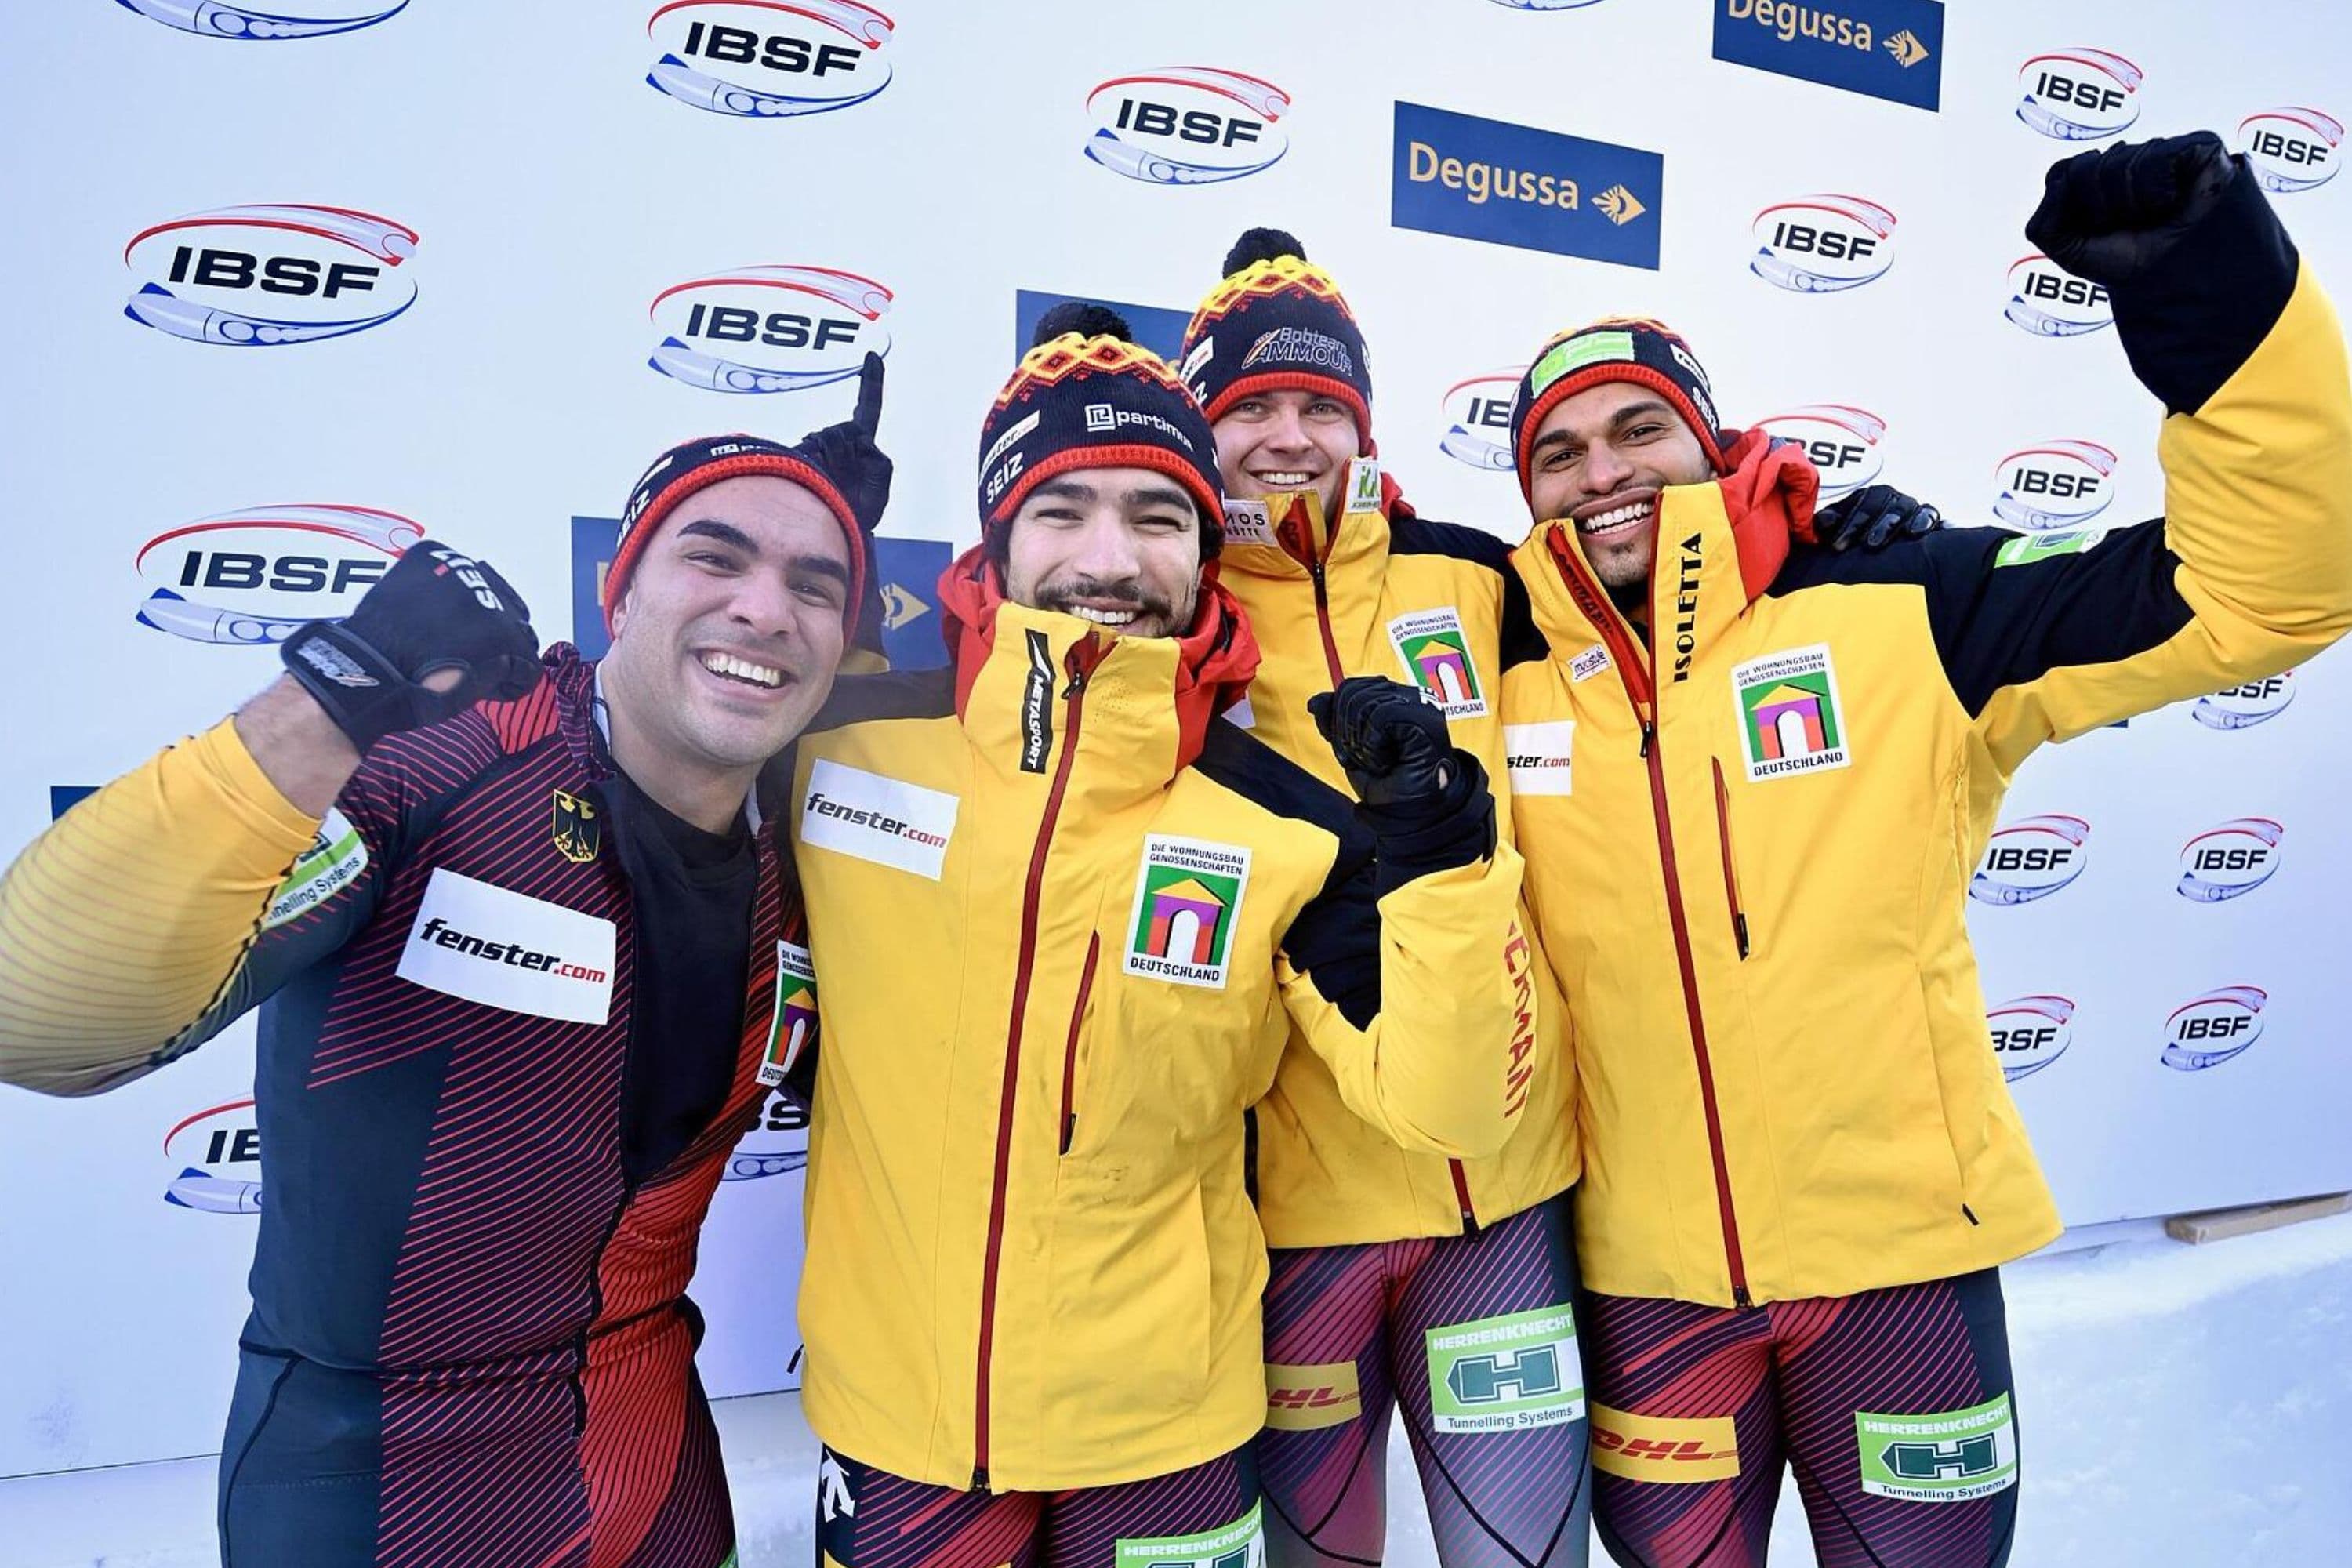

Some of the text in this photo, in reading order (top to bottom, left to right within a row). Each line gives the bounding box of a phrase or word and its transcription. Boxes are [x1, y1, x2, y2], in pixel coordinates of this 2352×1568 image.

[1729, 0, 1872, 52] Degussa
[684, 21, 861, 77] IBSF
[2036, 72, 2125, 114] IBSF
[1116, 99, 1262, 148] IBSF
[2252, 130, 2328, 166] IBSF
[1409, 141, 1578, 210] Degussa
[1773, 222, 1876, 263] IBSF
[169, 246, 380, 299] IBSF
[2024, 272, 2108, 307] IBSF
[685, 303, 860, 351] IBSF
[1279, 327, 1350, 352] Bobteam
[1255, 340, 1352, 376] AMMOUR
[1467, 397, 1511, 428] IB
[2013, 468, 2100, 499] IBSF
[180, 551, 387, 593] IBSF
[1674, 532, 1702, 683] ISOLETTA
[1753, 653, 1823, 673] WOHNUNGSBAU
[1026, 674, 1044, 769] METASPORT
[1507, 755, 1570, 769] ster.com
[1754, 751, 1844, 777] DEUTSCHLAND
[807, 792, 947, 848] fenster.com
[1149, 853, 1243, 876] GENOSSENSCHAFTEN
[1152, 844, 1166, 853] DIE
[1170, 846, 1244, 866] WOHNUNGSBAU
[1986, 848, 2072, 872] IBSF
[2194, 849, 2268, 870] IBSF
[315, 856, 361, 893] Systems
[420, 917, 607, 983] fenster.com
[1131, 956, 1221, 982] DEUTSCHLAND
[1990, 1027, 2056, 1051] BSF
[2178, 1015, 2252, 1041] IBSF
[1432, 1316, 1572, 1351] HERRENKNECHT
[1267, 1386, 1341, 1408] HL
[1448, 1406, 1573, 1429] Tunnelling Systems
[1592, 1425, 1715, 1461] DHL
[1882, 1478, 2007, 1500] Tunnelling Systems
